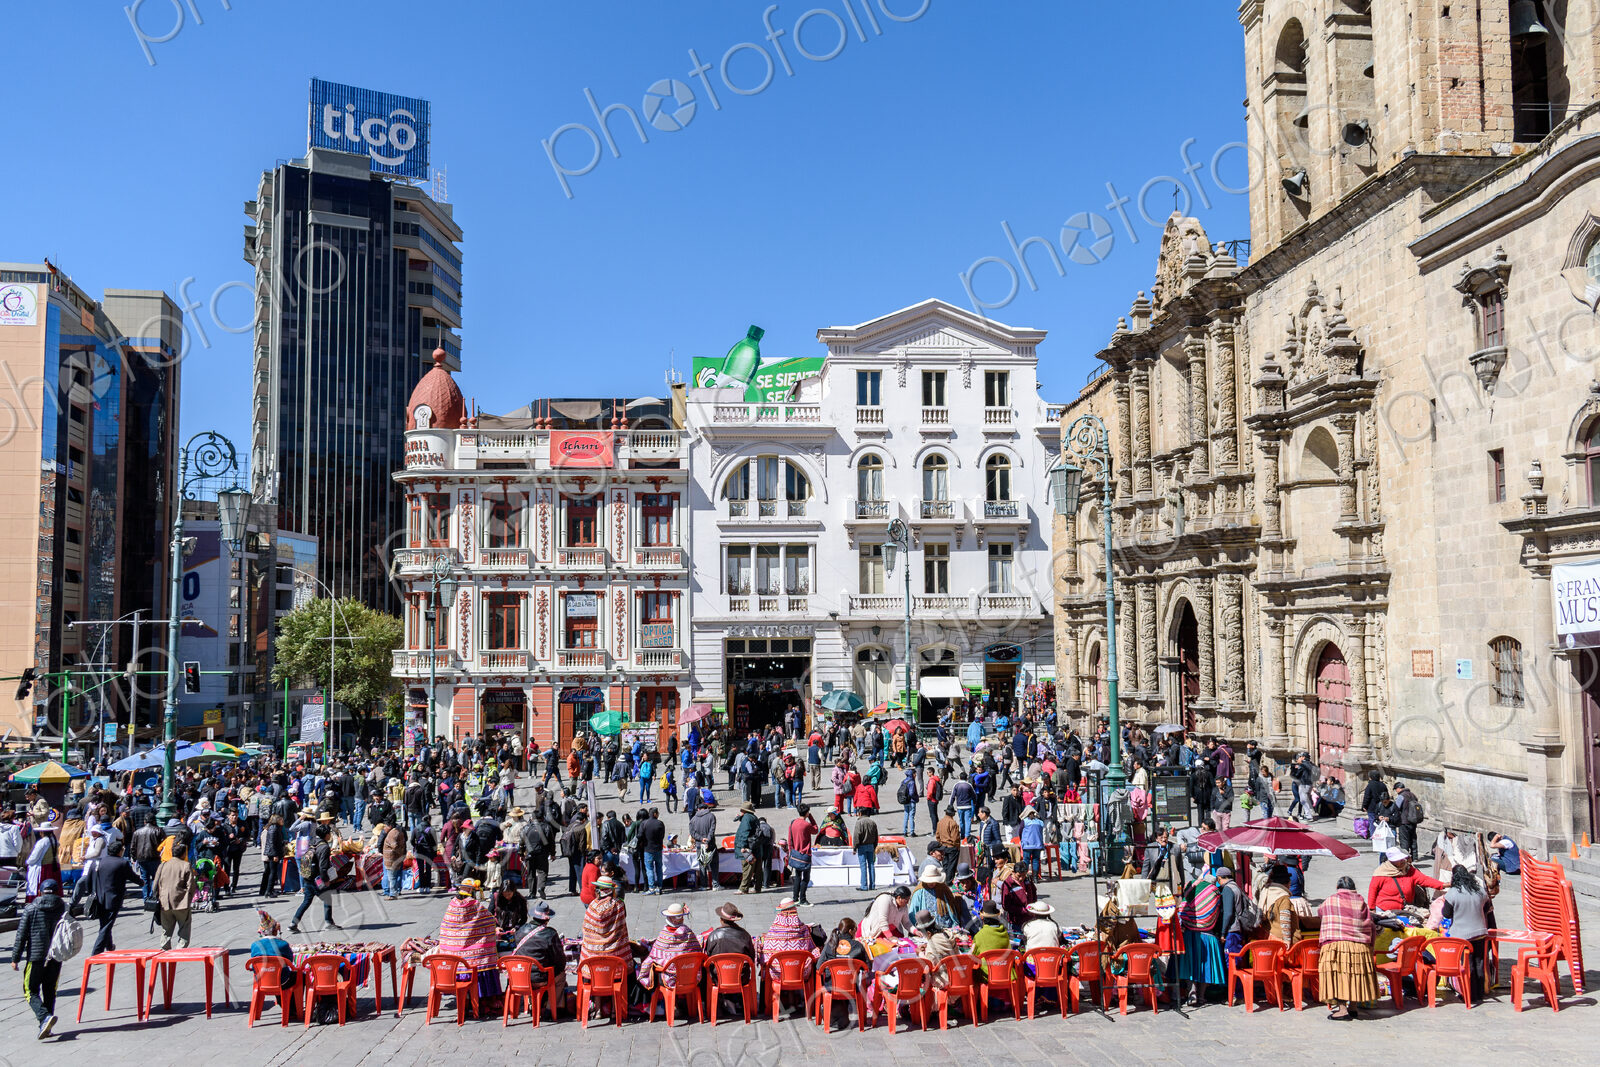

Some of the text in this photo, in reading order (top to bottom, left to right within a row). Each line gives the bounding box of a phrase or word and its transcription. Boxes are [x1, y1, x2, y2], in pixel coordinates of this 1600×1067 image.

[323, 103, 416, 166] tigo
[757, 373, 774, 389] SE
[563, 440, 600, 450] Ichuri
[1559, 595, 1600, 626] MUS
[643, 624, 672, 637] OPTICA
[726, 624, 814, 637] KAUTSCH
[643, 636, 672, 647] MERCED
